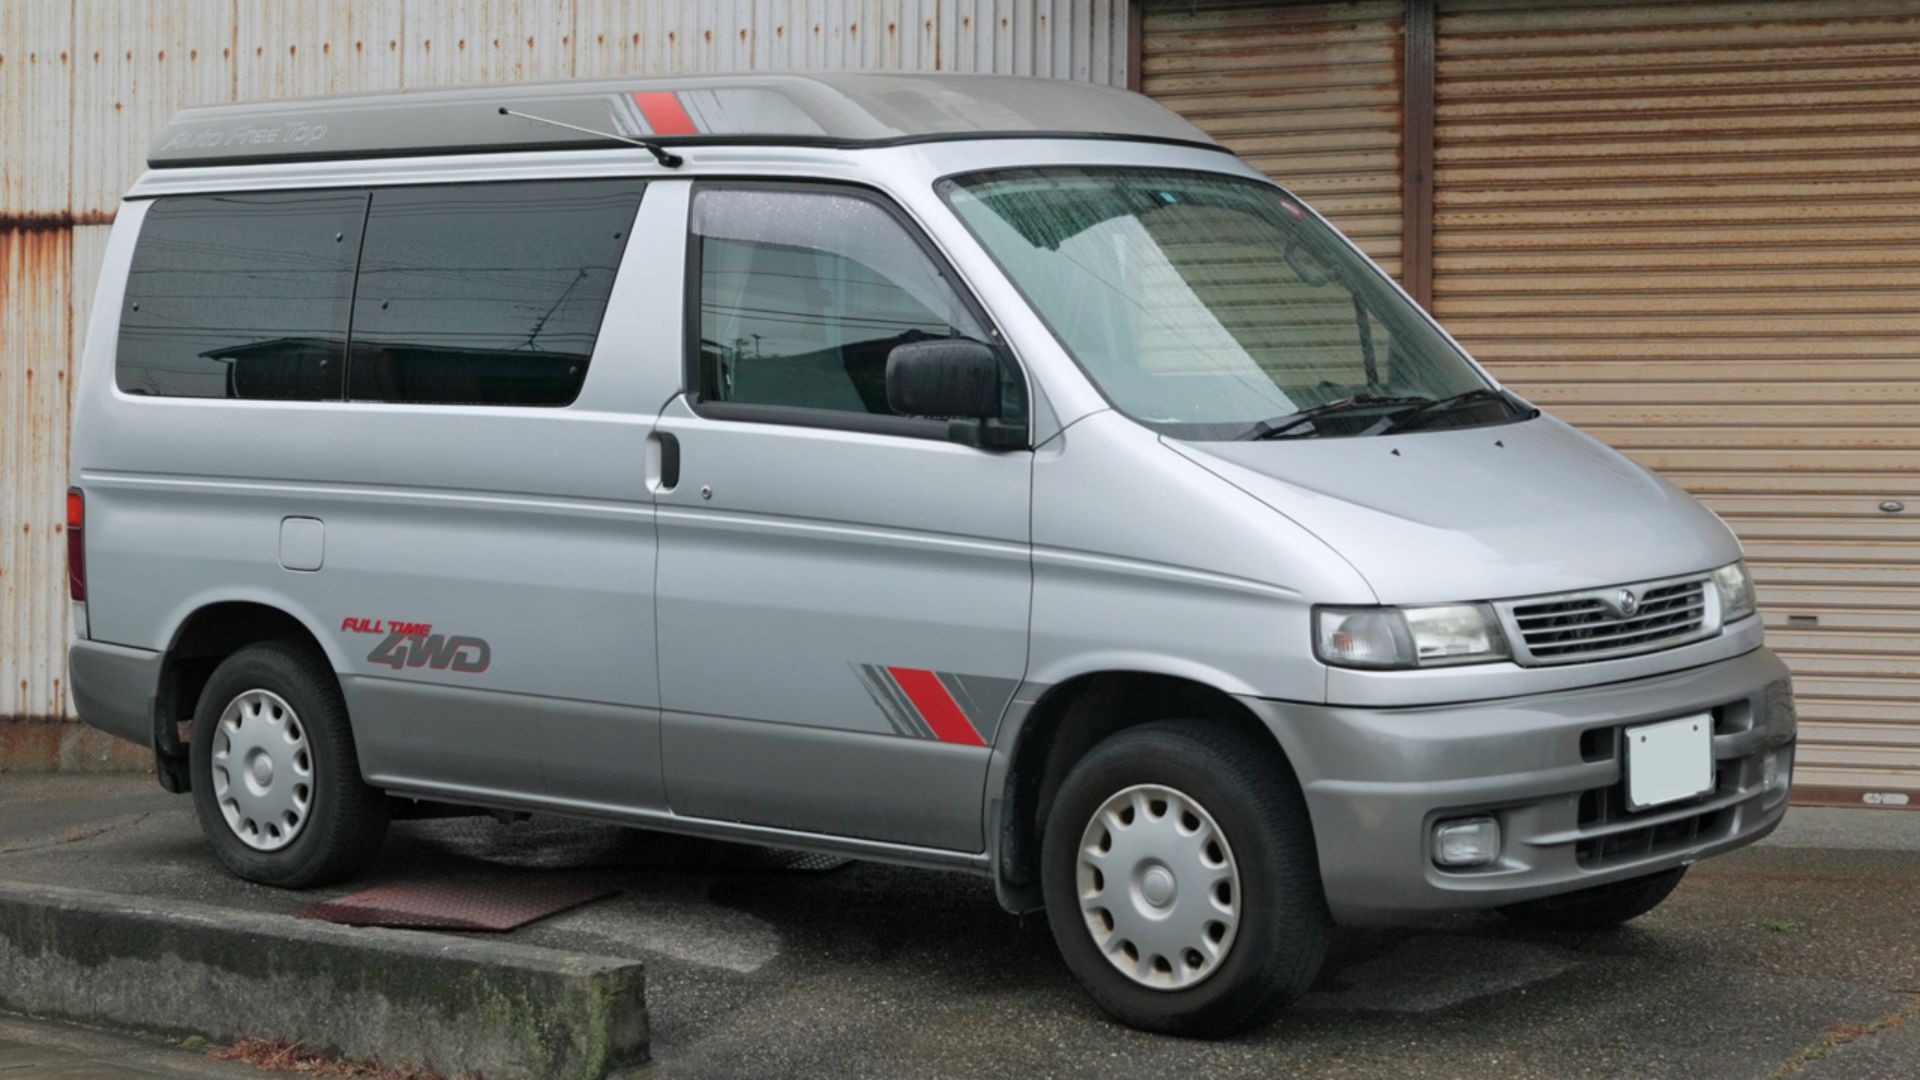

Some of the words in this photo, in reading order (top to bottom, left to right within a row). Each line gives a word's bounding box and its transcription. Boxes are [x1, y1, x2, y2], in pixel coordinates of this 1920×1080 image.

[341, 617, 384, 633] FULL
[387, 620, 432, 637] TIME
[367, 633, 491, 673] 4WD
